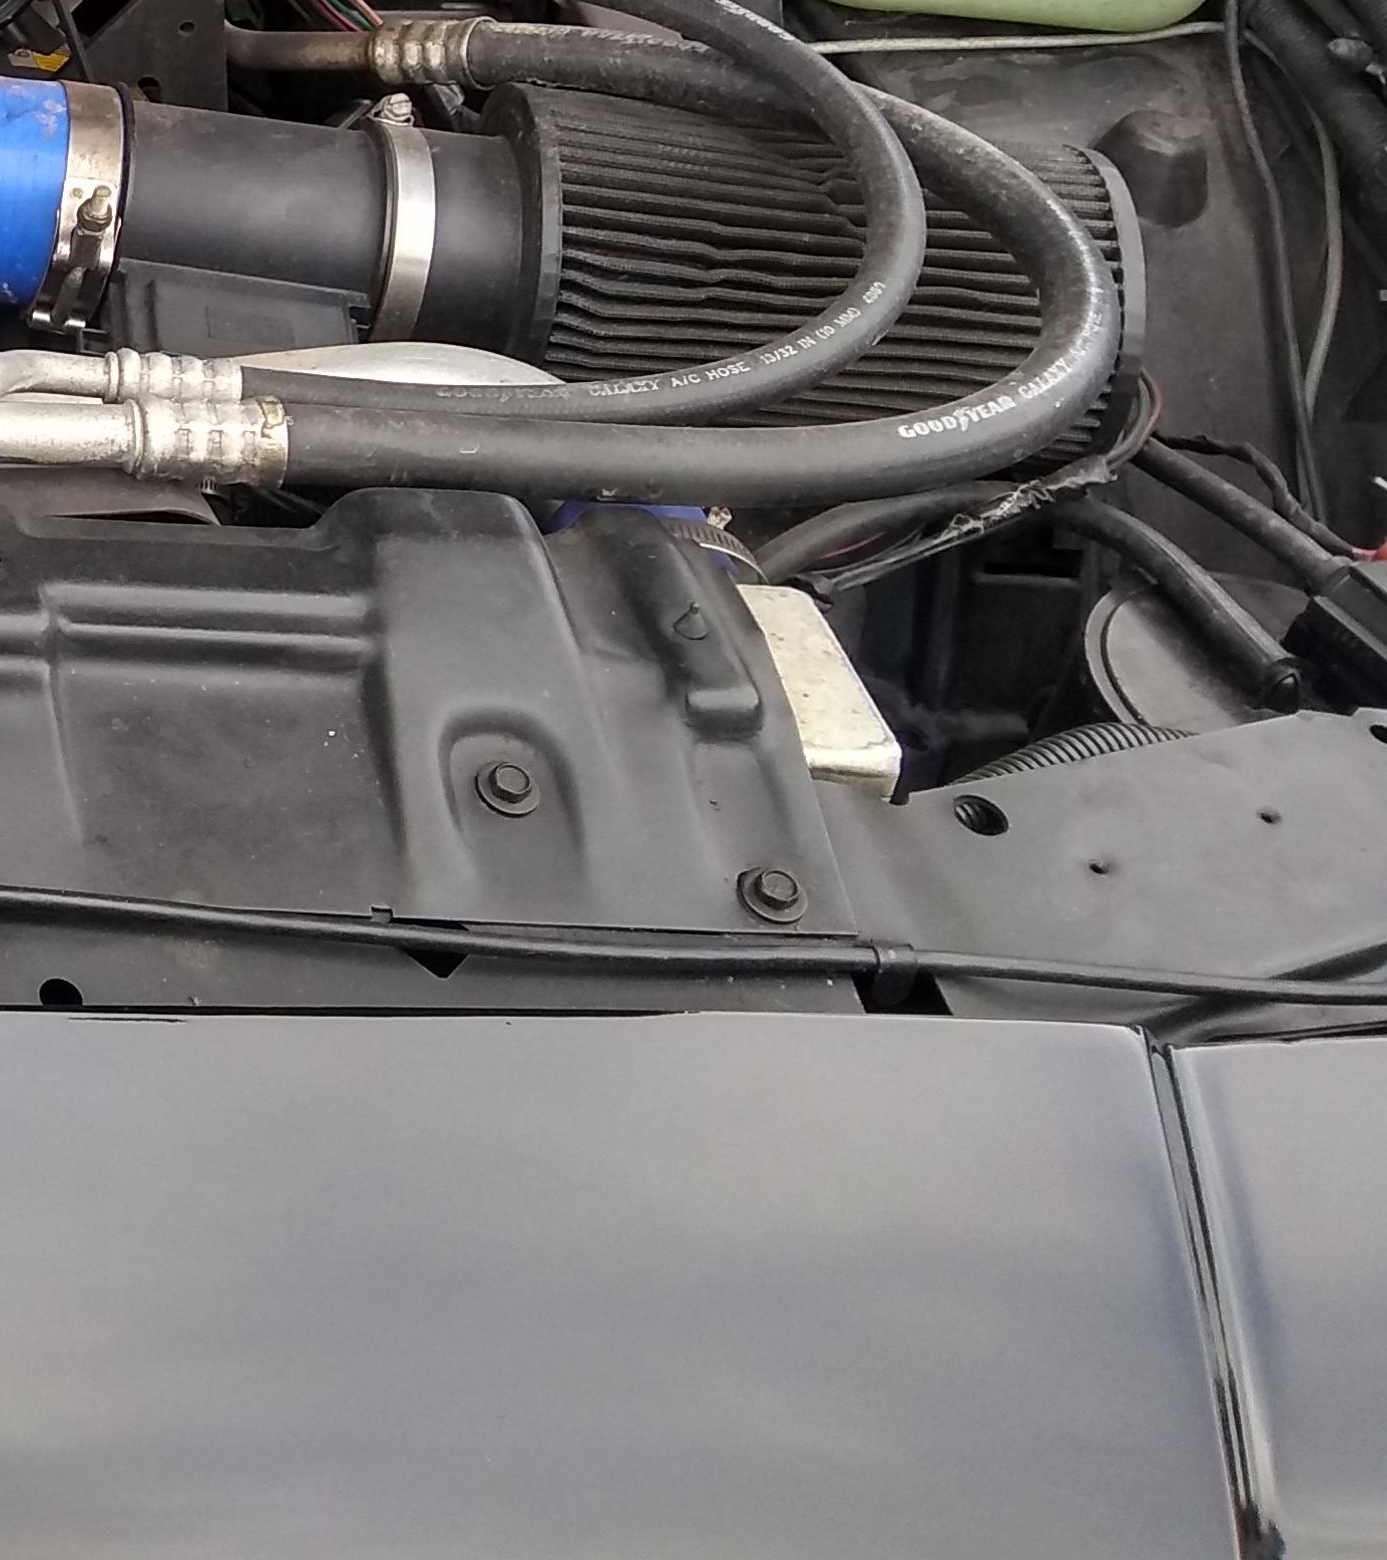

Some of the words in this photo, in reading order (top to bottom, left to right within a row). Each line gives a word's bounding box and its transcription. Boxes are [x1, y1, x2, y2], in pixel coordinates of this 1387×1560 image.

[671, 373, 701, 387] A/C
[707, 361, 751, 381] HOSE
[760, 345, 798, 365] 13/32
[797, 335, 816, 350] IN
[898, 395, 1017, 438] GOODYEAR
[1018, 357, 1072, 399] GALAXY
